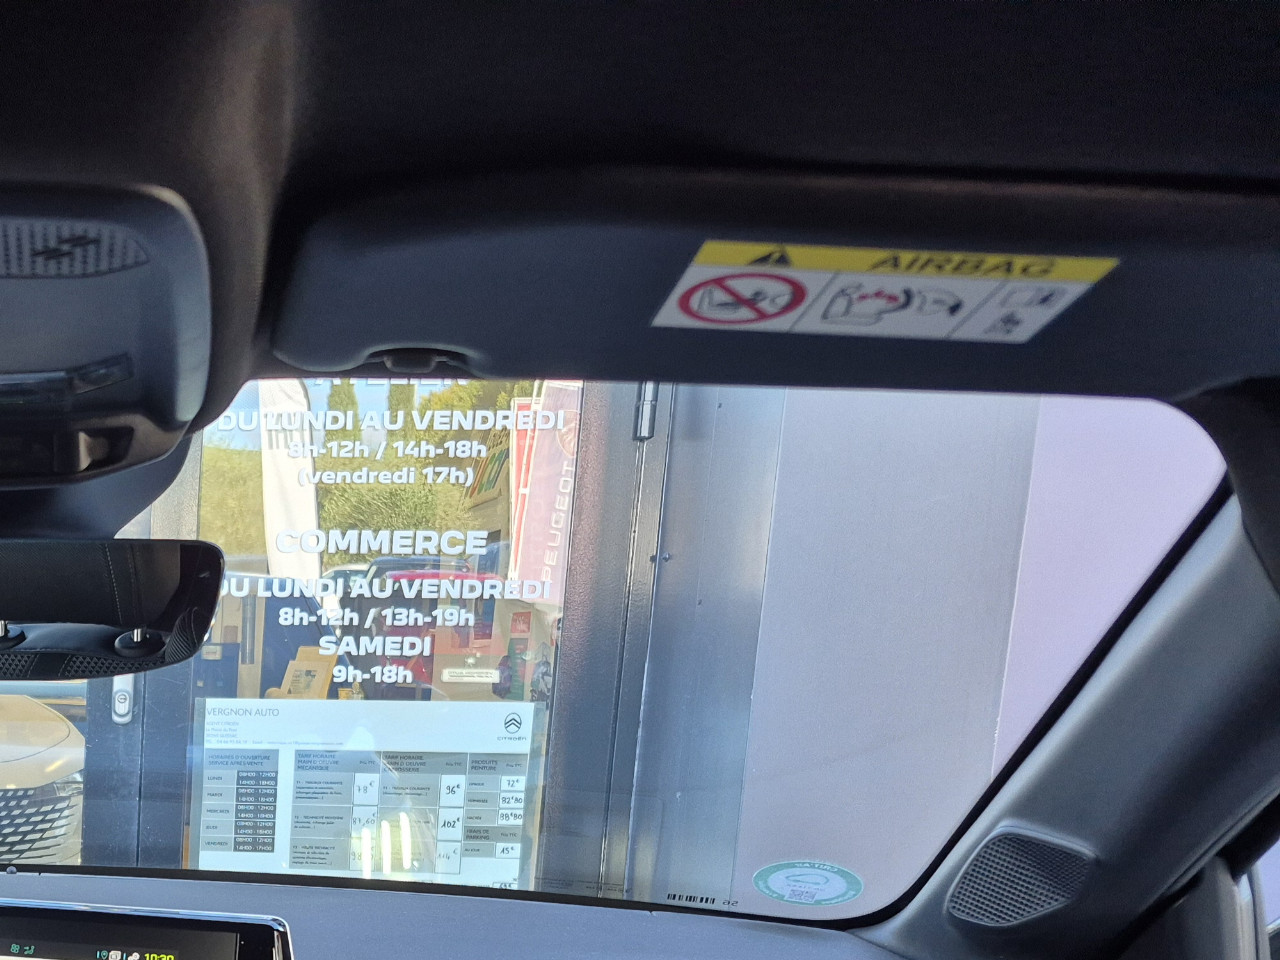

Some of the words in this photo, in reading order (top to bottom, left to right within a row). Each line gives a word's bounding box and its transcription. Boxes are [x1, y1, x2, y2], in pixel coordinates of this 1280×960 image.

[864, 254, 1057, 278] AIRBAG
[217, 410, 258, 431] DU
[266, 410, 354, 431] LUNDI
[360, 410, 404, 431] AU
[412, 410, 564, 431] VENDREDI
[288, 440, 370, 459] 8h-12h
[392, 440, 487, 459] 14h-18h
[298, 467, 416, 486] (vendredi
[422, 467, 474, 487] 17h)
[541, 460, 575, 582] PEUGEOT
[275, 529, 489, 555] COMMERCE
[257, 577, 344, 598] LUNDI
[350, 578, 394, 599] AU
[400, 578, 552, 599] VENDREDI
[278, 607, 359, 626] 8h-12h
[381, 608, 475, 627] 13h-19h
[318, 635, 432, 657] SAMEDI
[332, 665, 414, 683] 9h-18h
[207, 708, 252, 717] VERGNON
[254, 708, 280, 717] AUTO
